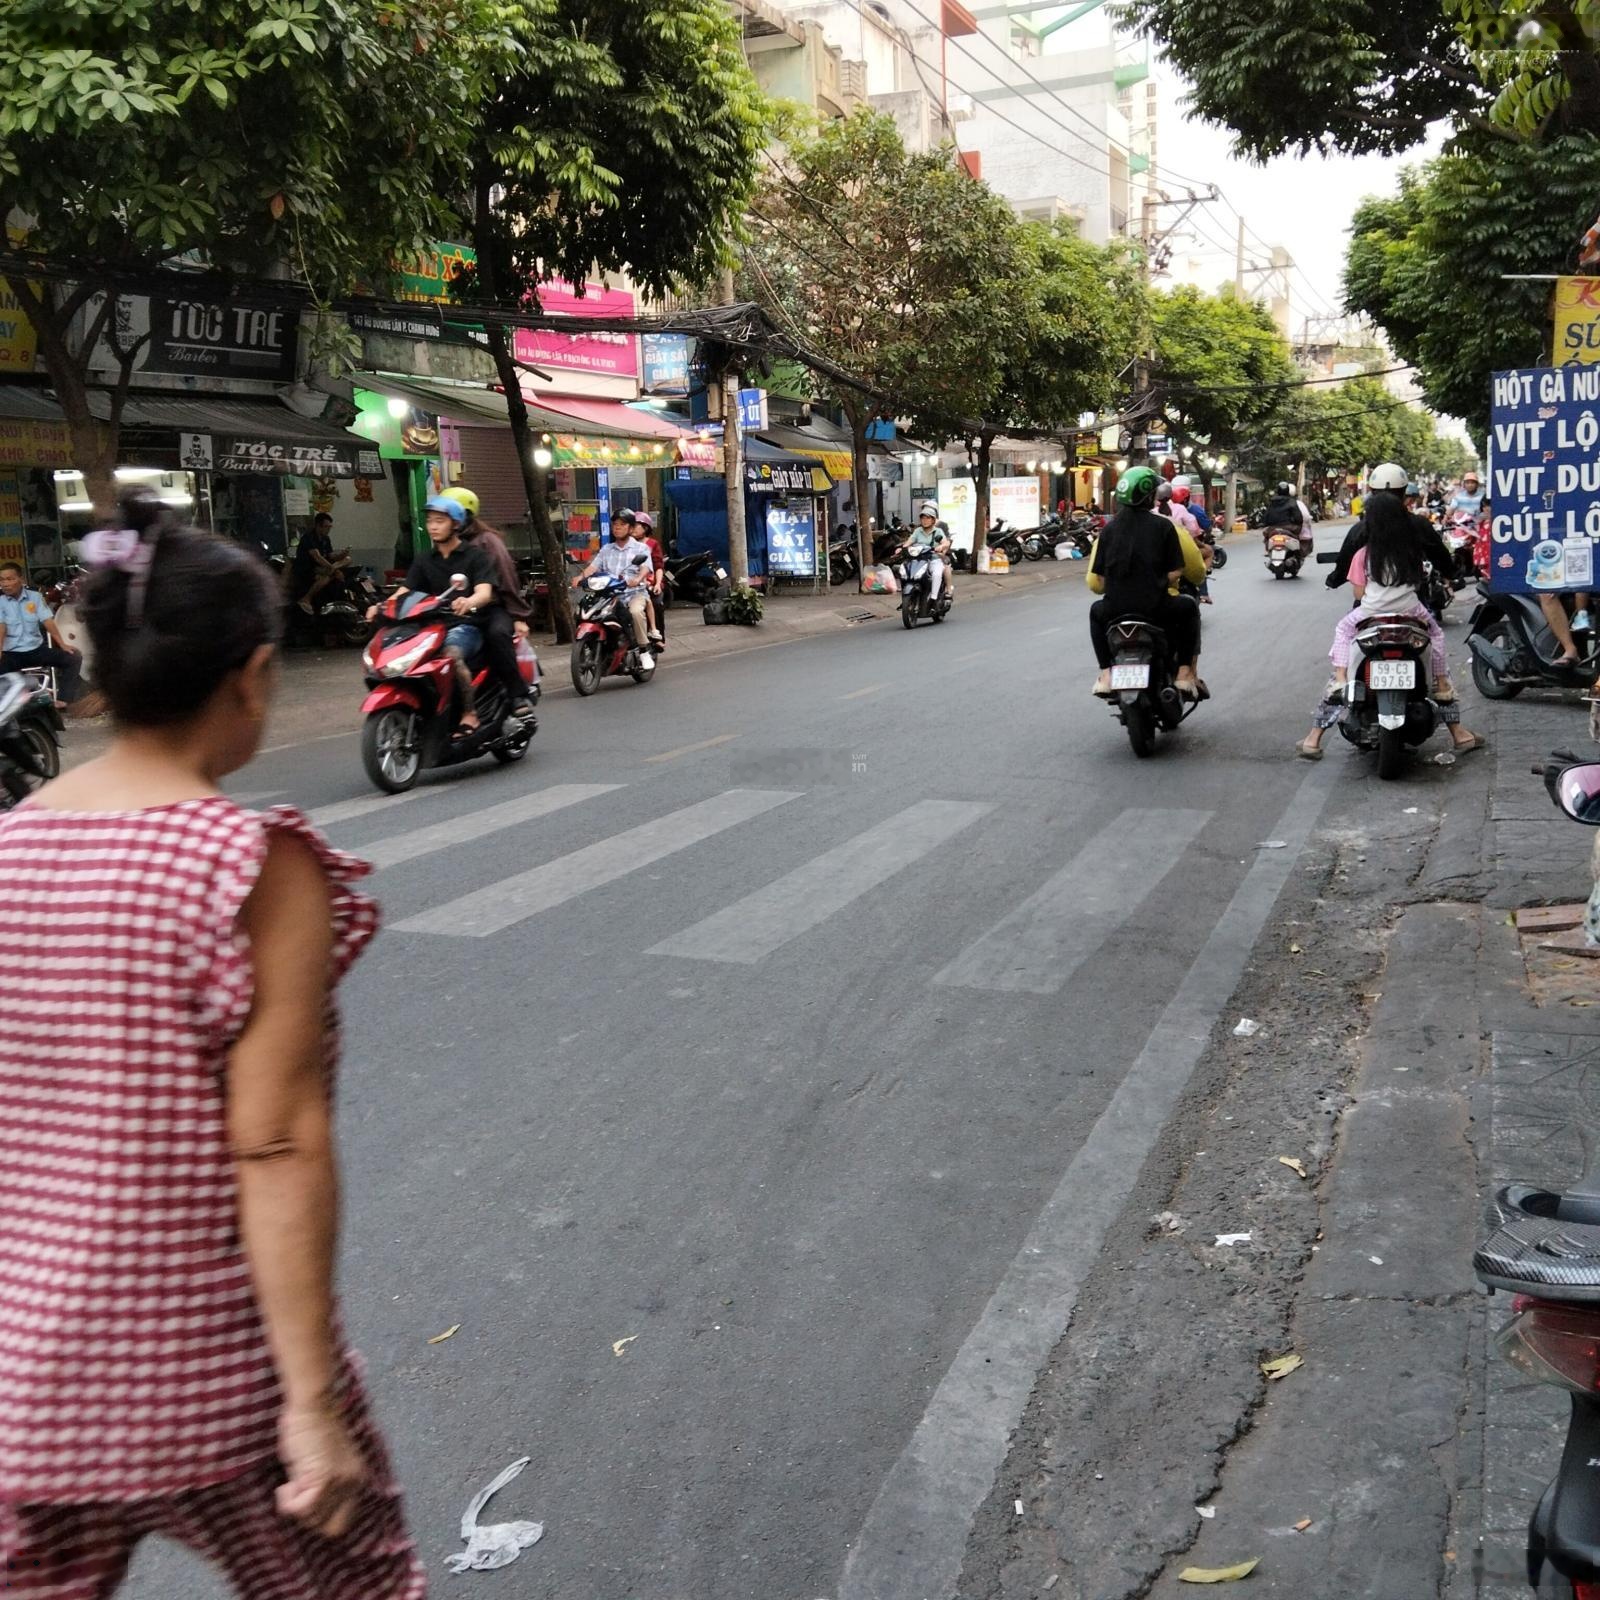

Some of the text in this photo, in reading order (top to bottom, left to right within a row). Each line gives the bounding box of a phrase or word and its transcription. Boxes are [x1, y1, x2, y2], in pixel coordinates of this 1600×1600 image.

[1494, 369, 1533, 409] HỘT
[1540, 368, 1566, 403] GÀ
[1494, 410, 1599, 457] VỊT LỘ
[218, 457, 275, 472] Barber
[235, 441, 338, 461] TÓC TRẺ
[1494, 466, 1545, 502] VỊT
[772, 529, 808, 547] SẤY
[1491, 506, 1554, 543] CÚT
[1373, 675, 1412, 687] 097.65
